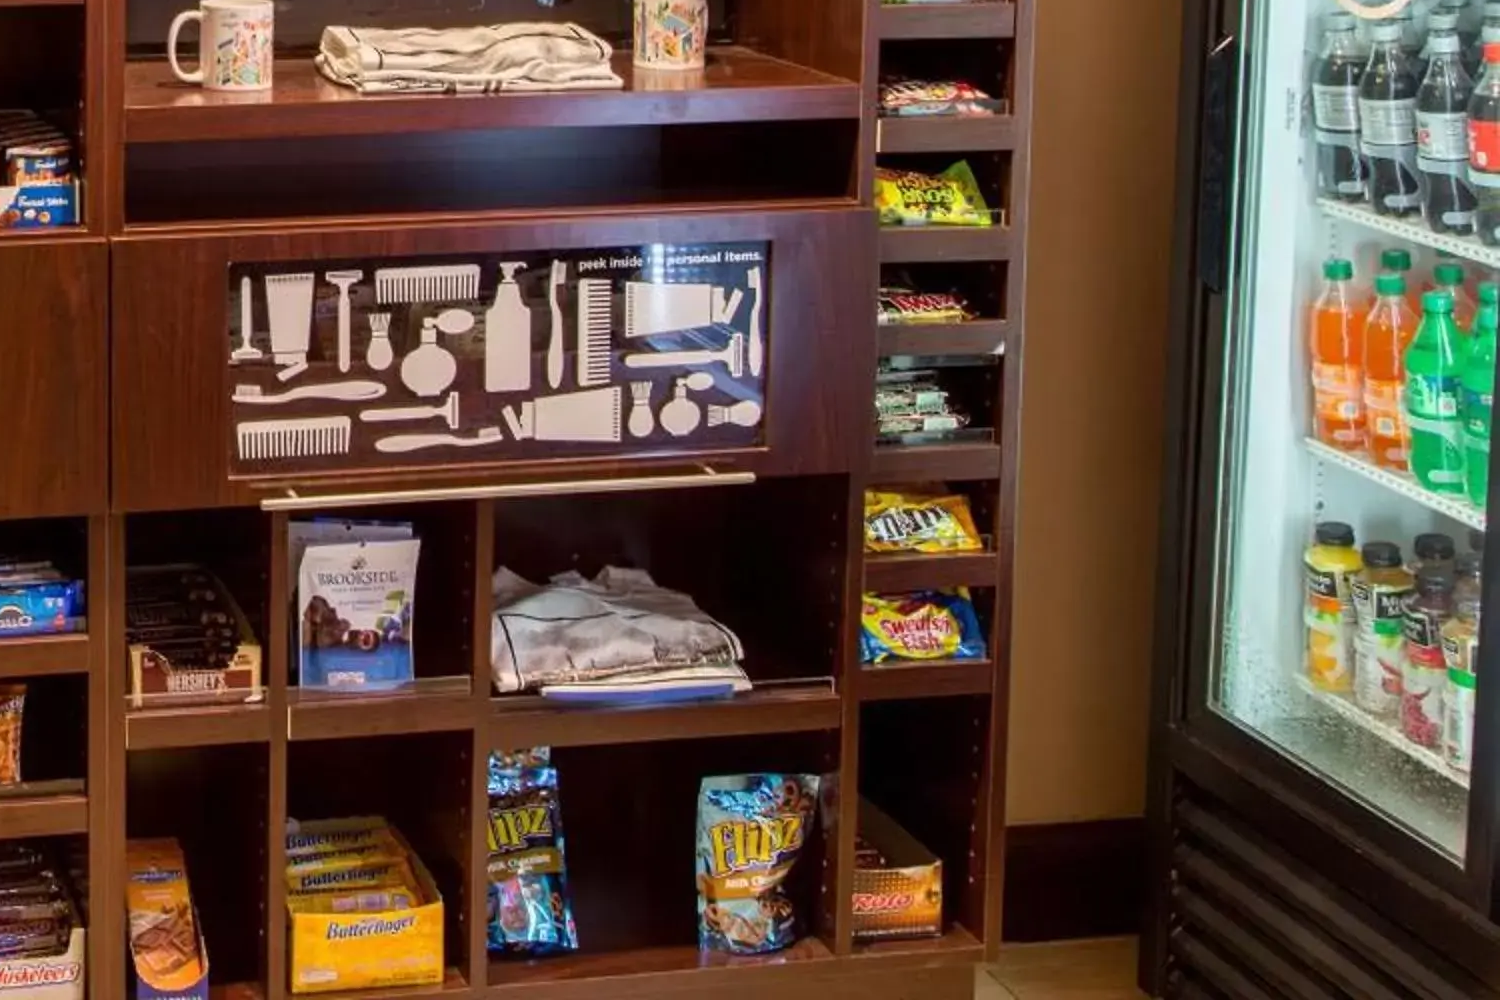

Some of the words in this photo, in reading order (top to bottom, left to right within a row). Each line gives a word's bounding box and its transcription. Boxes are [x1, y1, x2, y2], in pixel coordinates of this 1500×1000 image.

[578, 260, 607, 273] peek
[609, 255, 644, 269] inside
[666, 252, 722, 268] personal
[724, 251, 764, 263] items.
[317, 570, 398, 587] BROOKSIDE
[879, 612, 951, 642] Swedish
[900, 628, 942, 652] Fish
[167, 671, 228, 693] HERSHEY'S
[301, 864, 389, 889] Butterfinger
[326, 914, 417, 941] Butterfinger
